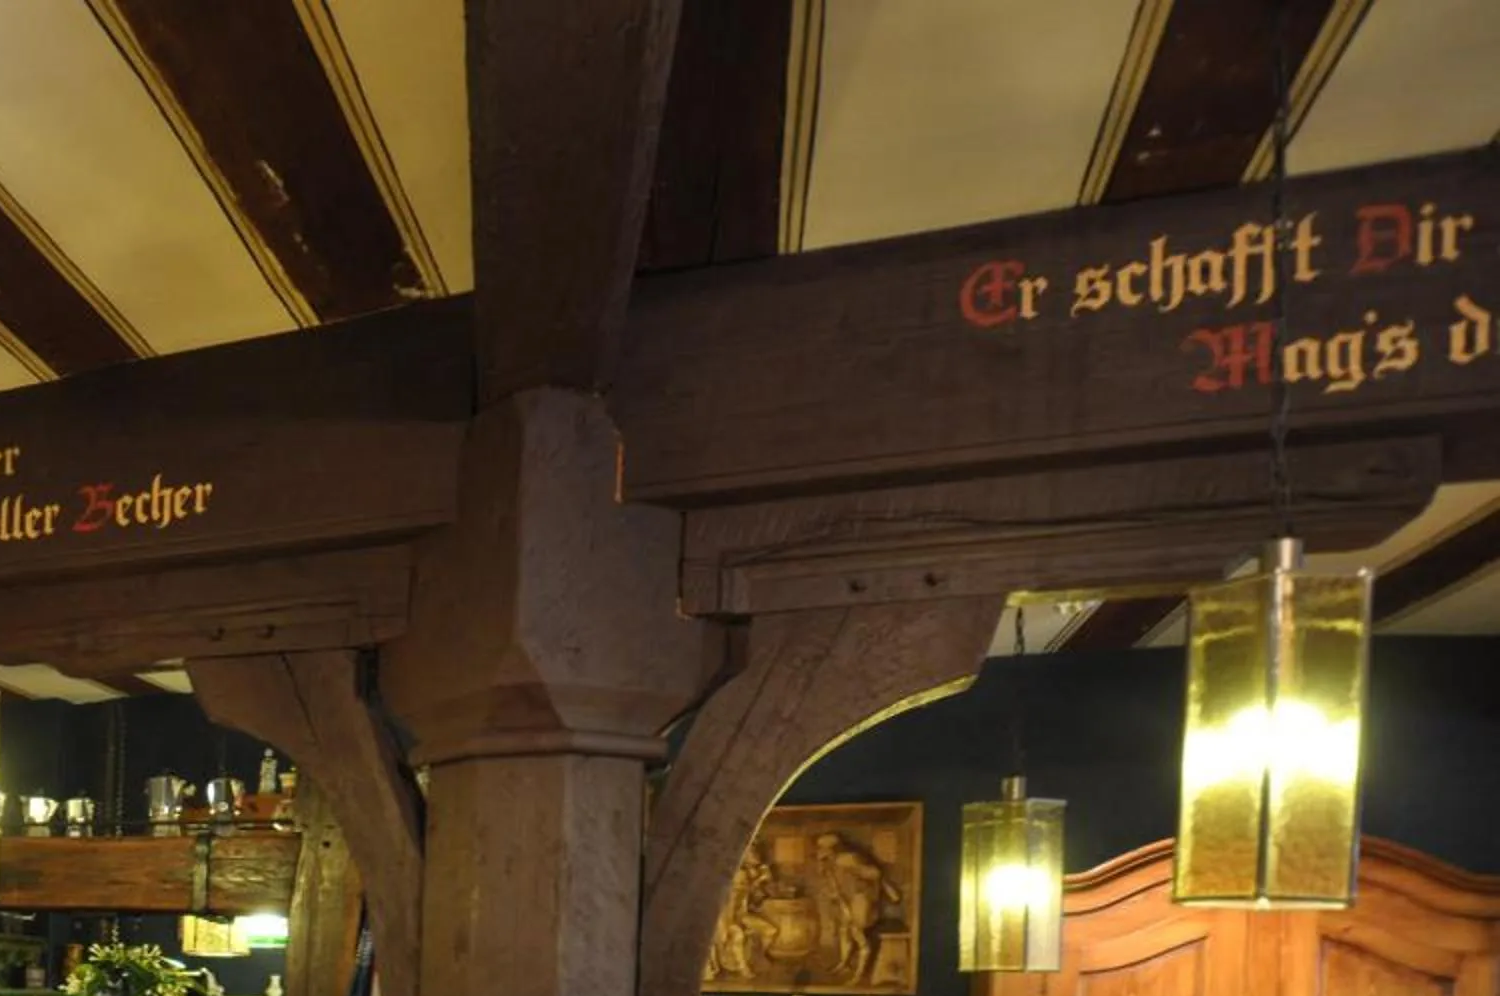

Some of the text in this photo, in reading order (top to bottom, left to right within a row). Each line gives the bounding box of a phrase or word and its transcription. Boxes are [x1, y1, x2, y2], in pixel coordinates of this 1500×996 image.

[959, 202, 1475, 328] Er schafft Dir
[72, 473, 214, 532] Becher
